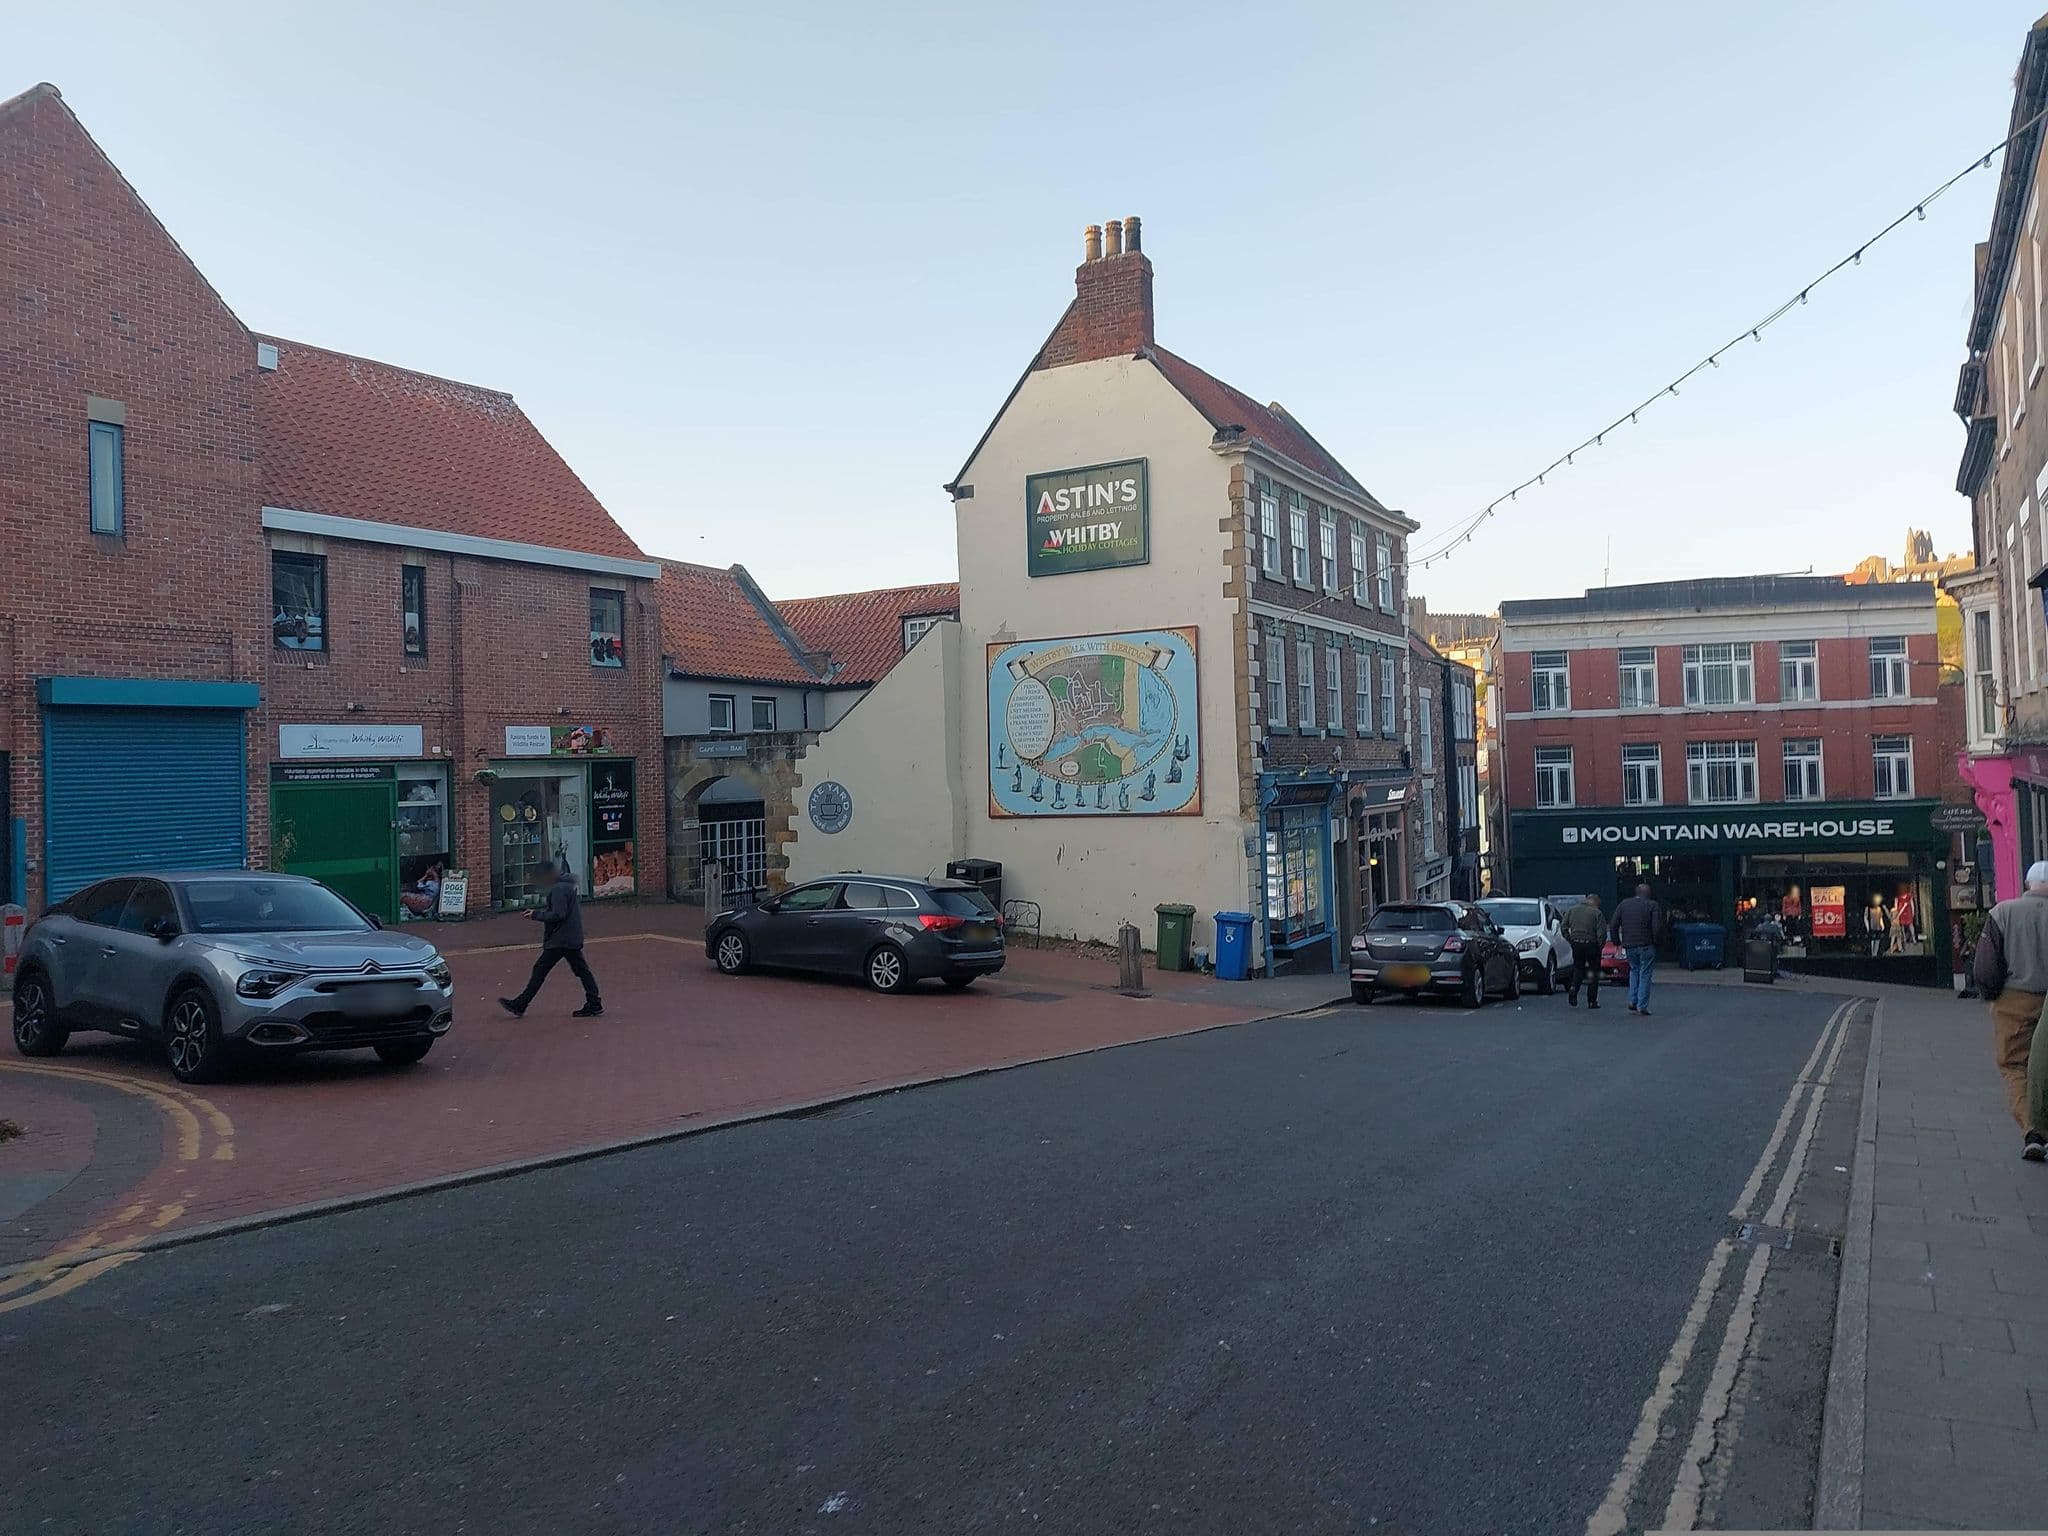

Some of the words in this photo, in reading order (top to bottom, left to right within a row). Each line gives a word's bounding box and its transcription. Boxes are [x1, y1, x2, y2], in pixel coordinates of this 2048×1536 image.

[1037, 478, 1137, 514] ASTIN'S
[1036, 513, 1070, 524] PROPERTY
[1071, 511, 1091, 519] SALES
[1091, 508, 1105, 517] AND
[1106, 504, 1138, 514] LETTINGS
[1049, 521, 1122, 547] WHITBY
[1098, 537, 1138, 549] COTTAGES
[1030, 649, 1062, 669] WHITBY
[1062, 644, 1085, 655] WALK
[1085, 641, 1110, 651] WITH
[810, 785, 825, 812] THE
[828, 783, 850, 811] YARD
[1581, 824, 1719, 843] MOUNTAIN
[1722, 819, 1895, 839] WAREHOUSE
[445, 883, 463, 891] DOGS
[1814, 895, 1841, 903] SALE
